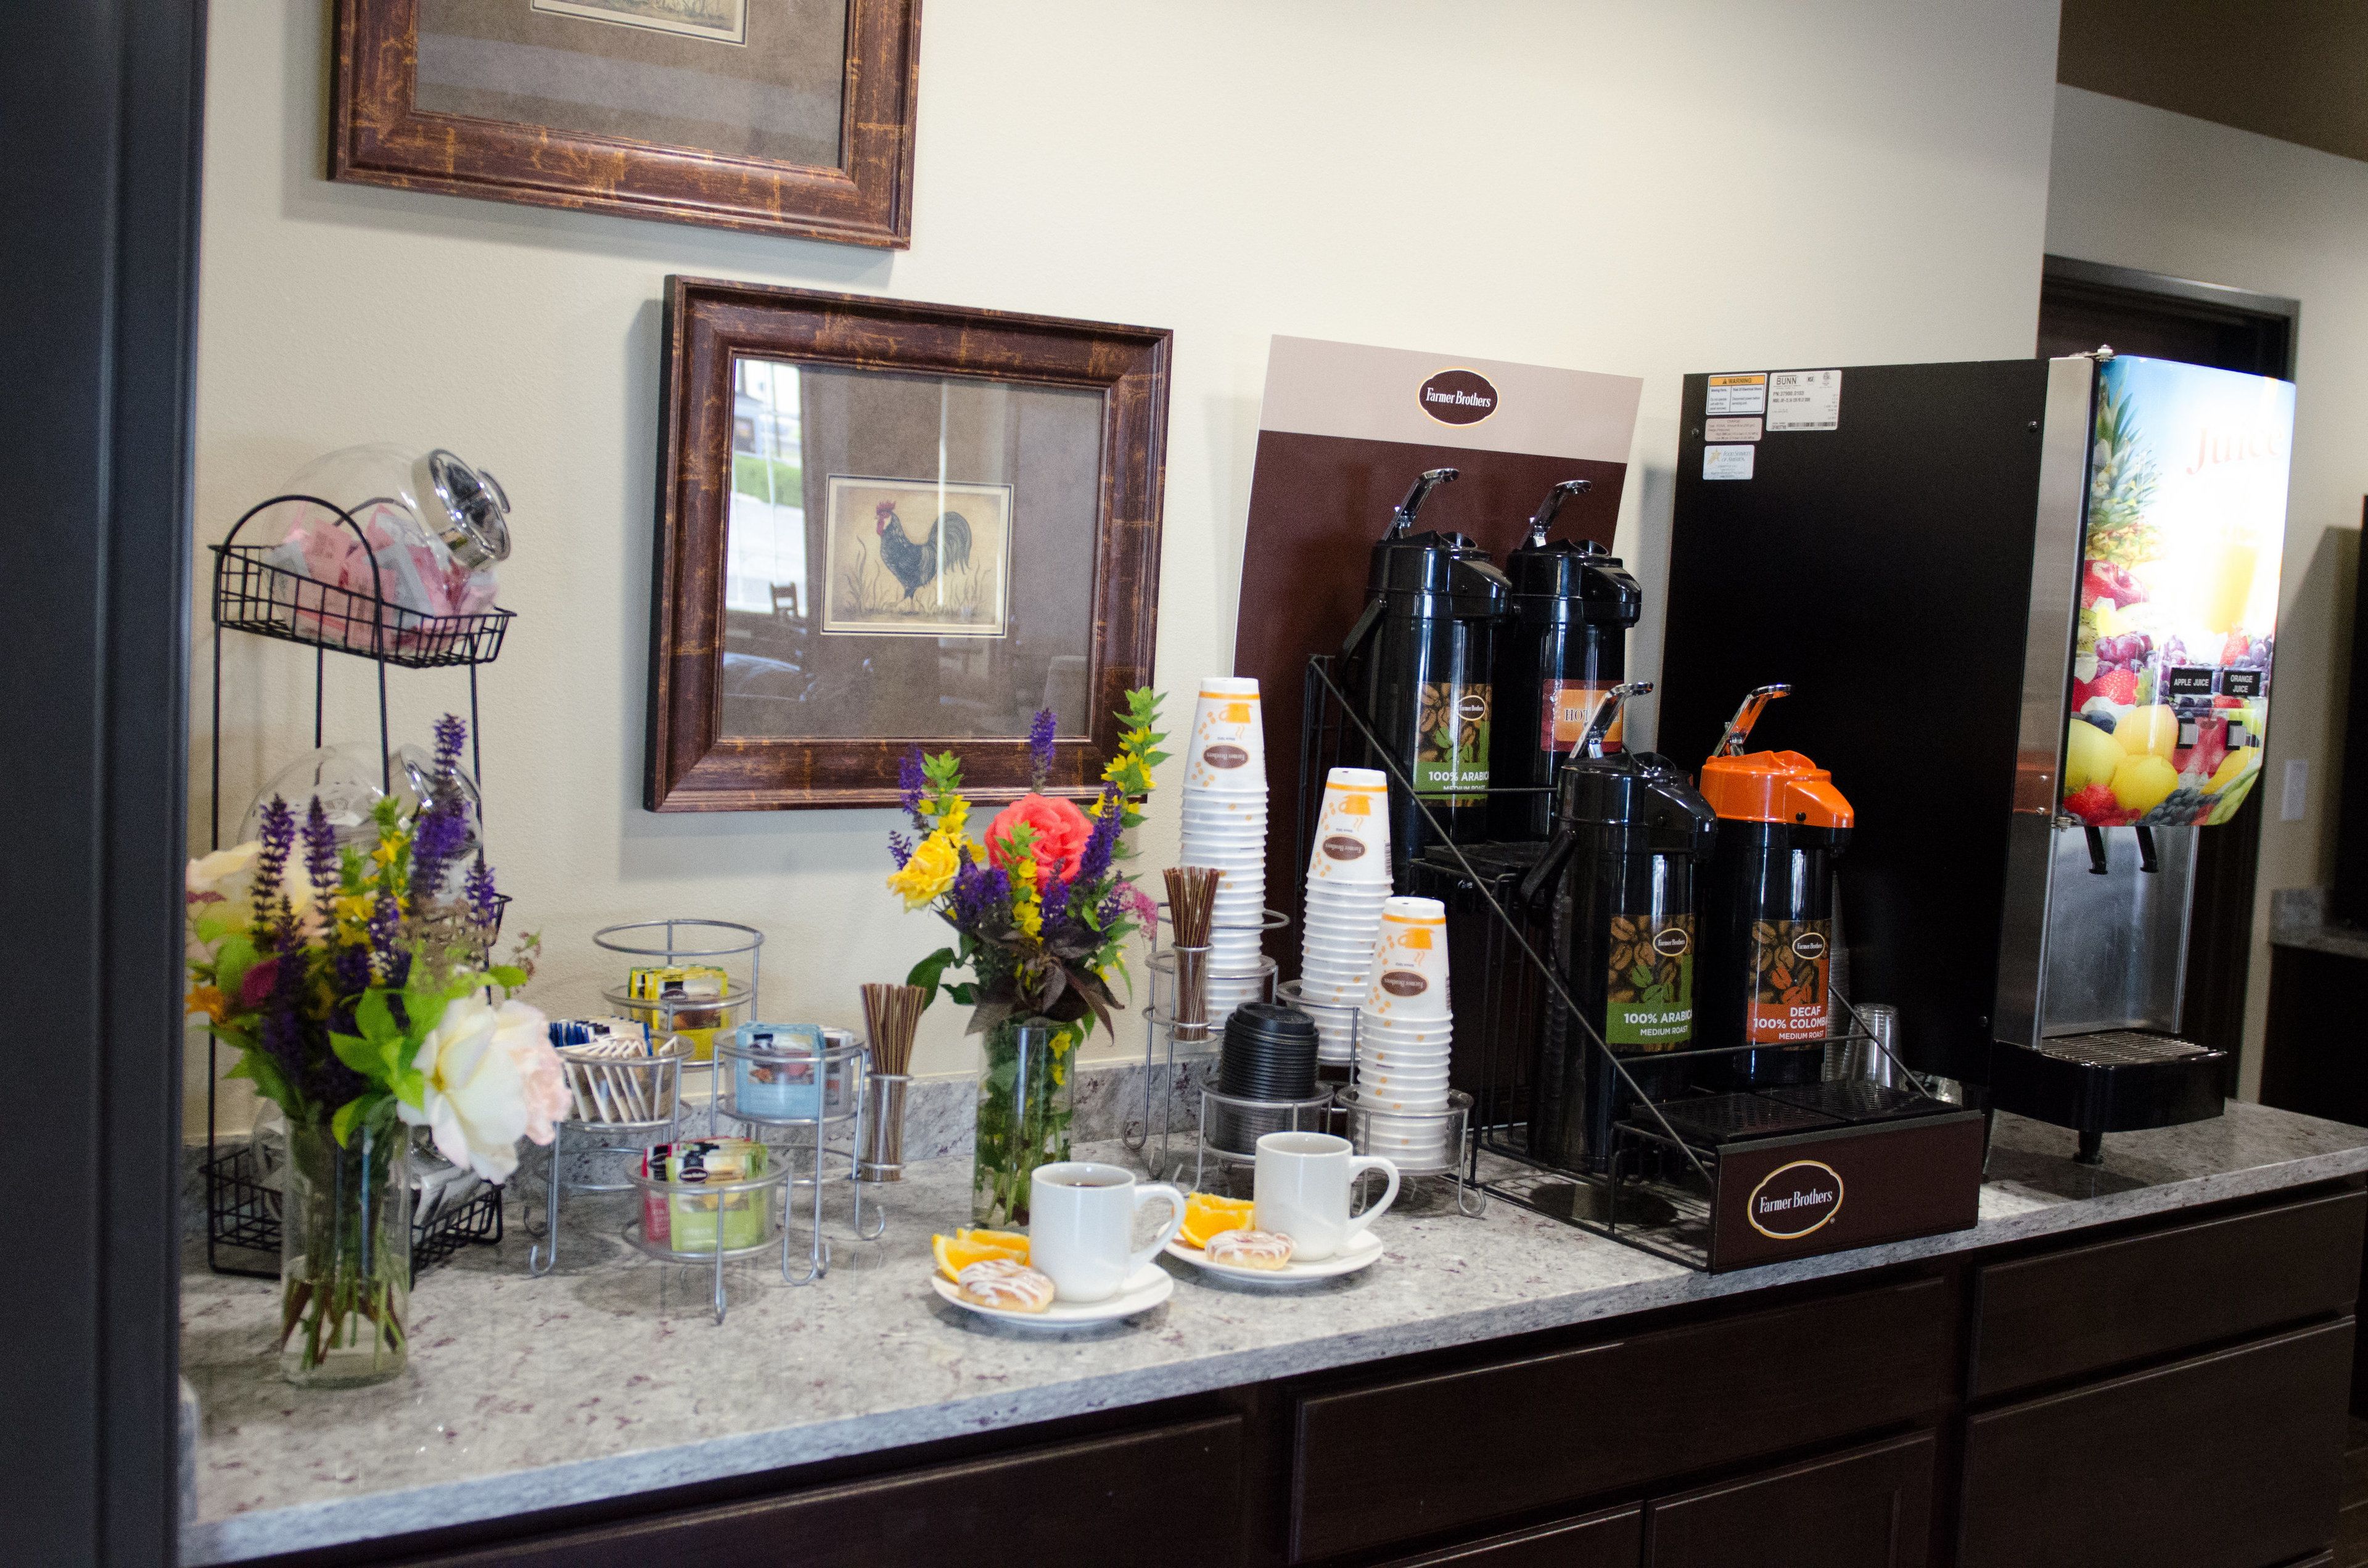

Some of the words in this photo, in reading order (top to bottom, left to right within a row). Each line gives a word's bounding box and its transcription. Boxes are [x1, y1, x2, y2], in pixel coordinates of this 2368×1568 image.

[1426, 387, 1455, 403] Farmer
[1455, 390, 1491, 407] Brothers
[2230, 675, 2253, 683] ORANGE
[1565, 709, 1591, 721] HOT
[1428, 771, 1458, 781] 100%
[1461, 770, 1489, 781] ARABIC
[1790, 1006, 1821, 1017] DECAF
[1624, 1013, 1658, 1024] 100%
[1753, 1017, 1786, 1028] 100%
[1790, 1016, 1827, 1028] COLOMB
[1640, 1028, 1670, 1036] MEDIUM
[1671, 1025, 1688, 1034] ROAST
[1809, 1030, 1823, 1038] ROAST
[1759, 1196, 1792, 1213] Farmer
[1793, 1188, 1833, 1208] Brothers
